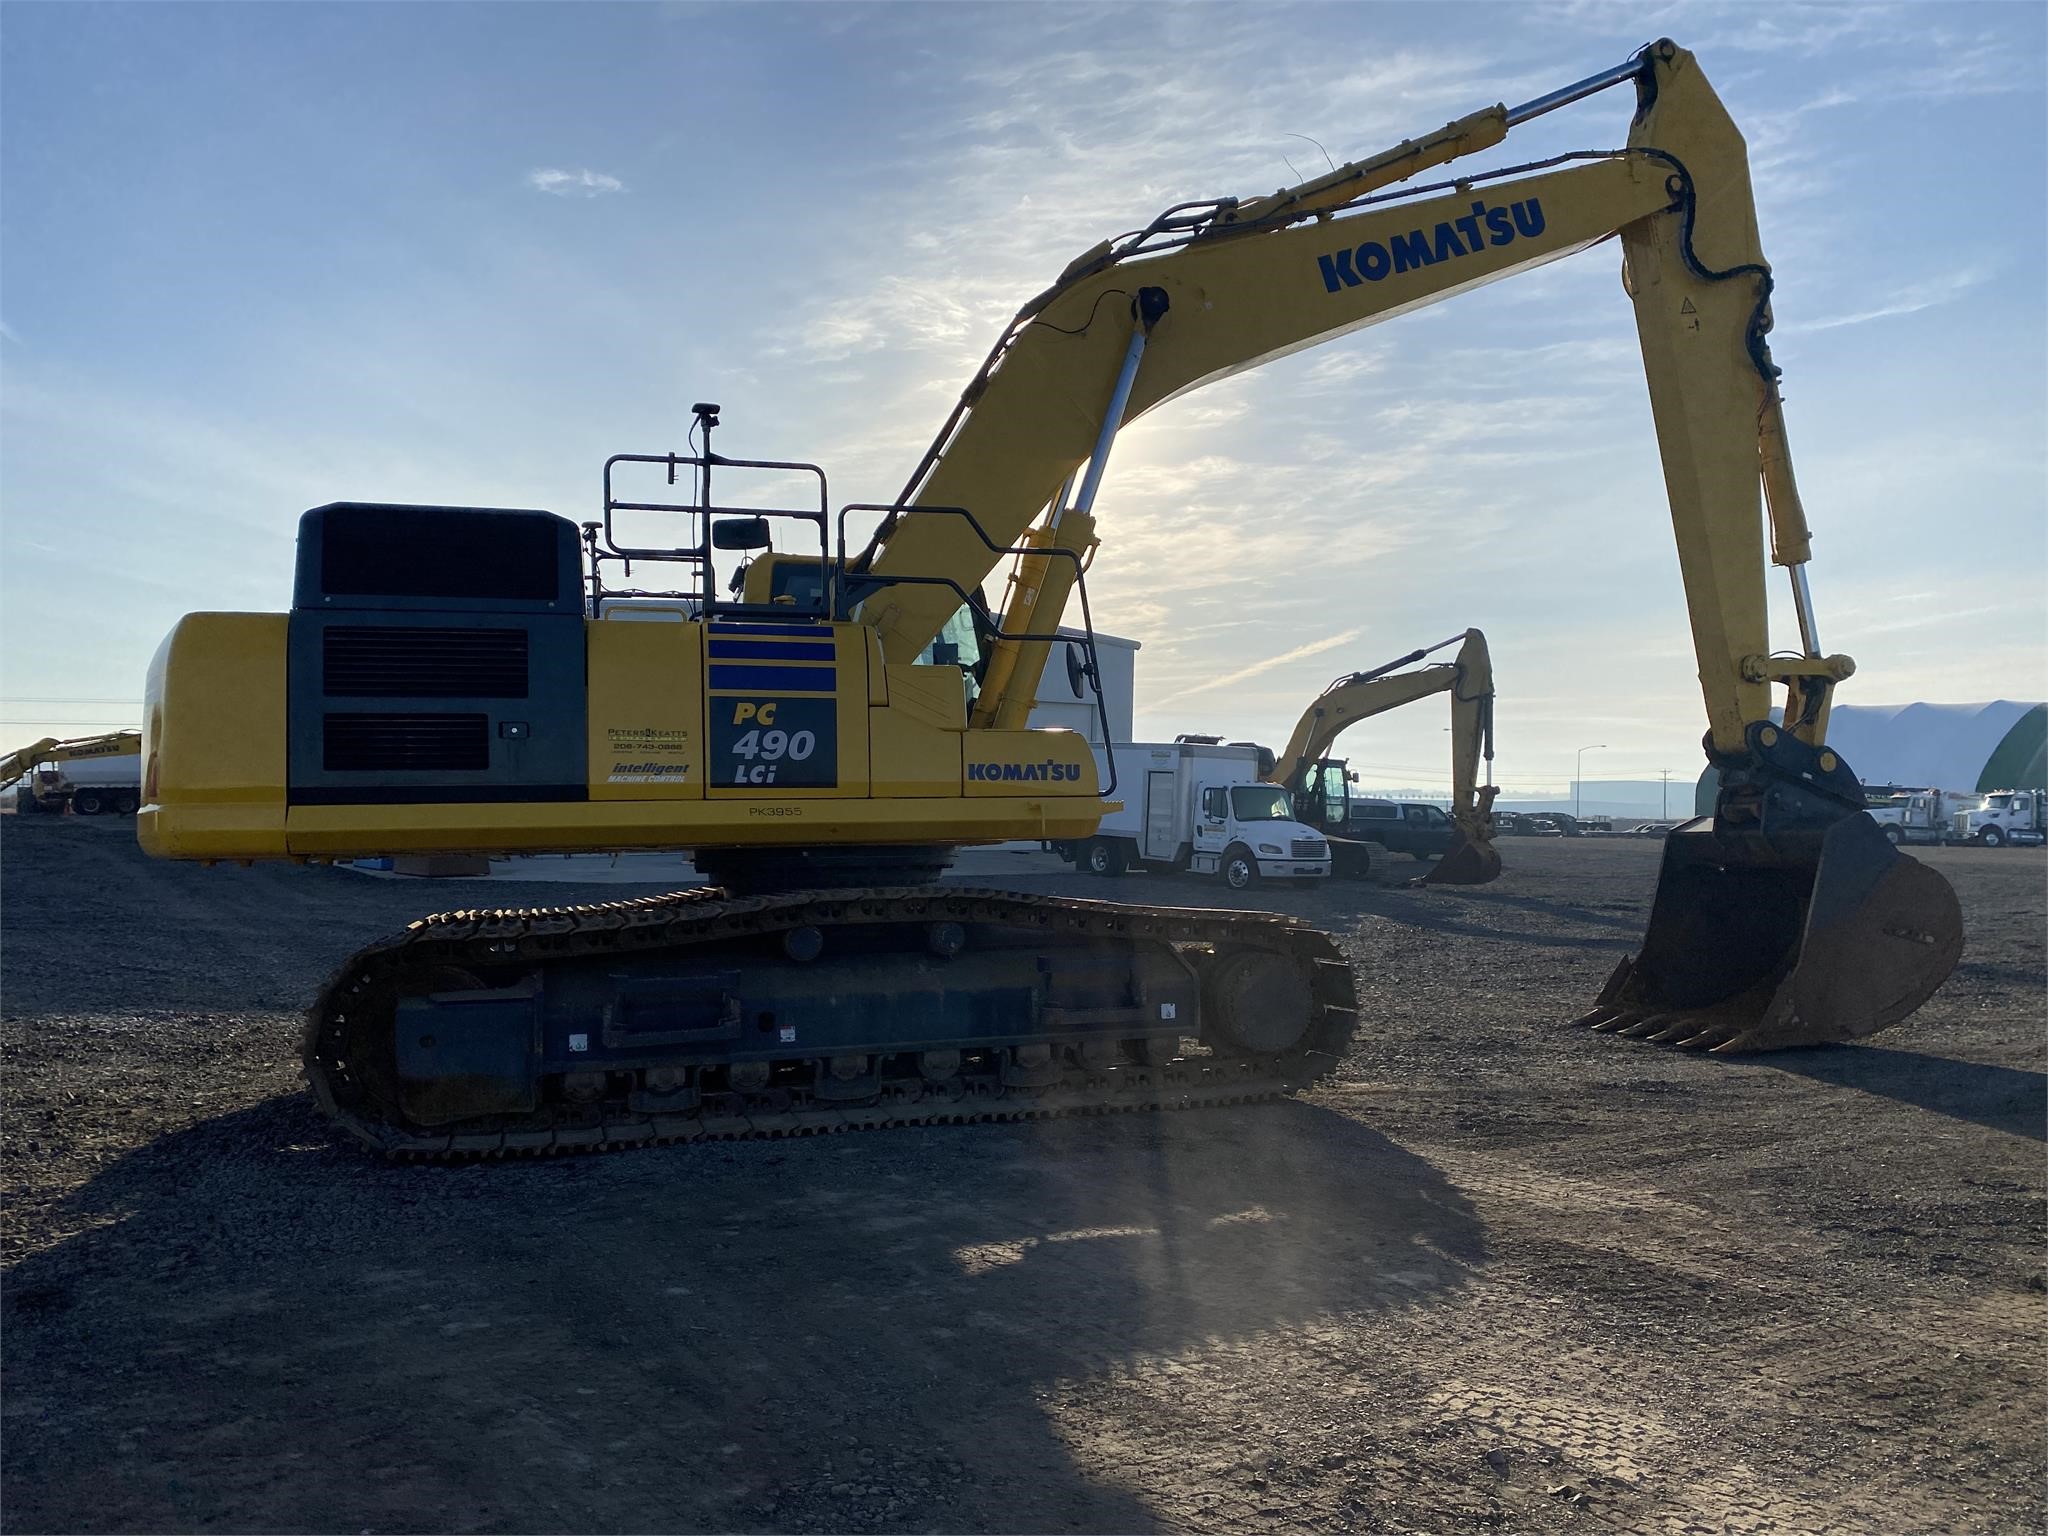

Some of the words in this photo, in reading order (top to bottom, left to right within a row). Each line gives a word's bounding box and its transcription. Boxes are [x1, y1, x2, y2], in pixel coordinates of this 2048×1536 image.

[1317, 197, 1546, 293] KOMATSU
[732, 702, 777, 726] PC
[608, 728, 645, 737] PETERS
[651, 729, 688, 737] KEATTS
[732, 730, 816, 761] 490
[612, 762, 690, 775] intelligent
[734, 764, 776, 784] LCi
[968, 759, 1080, 782] KOMATSU
[607, 775, 647, 783] MACHINE
[647, 775, 685, 783] CONTROL
[749, 807, 802, 816] PK3955
